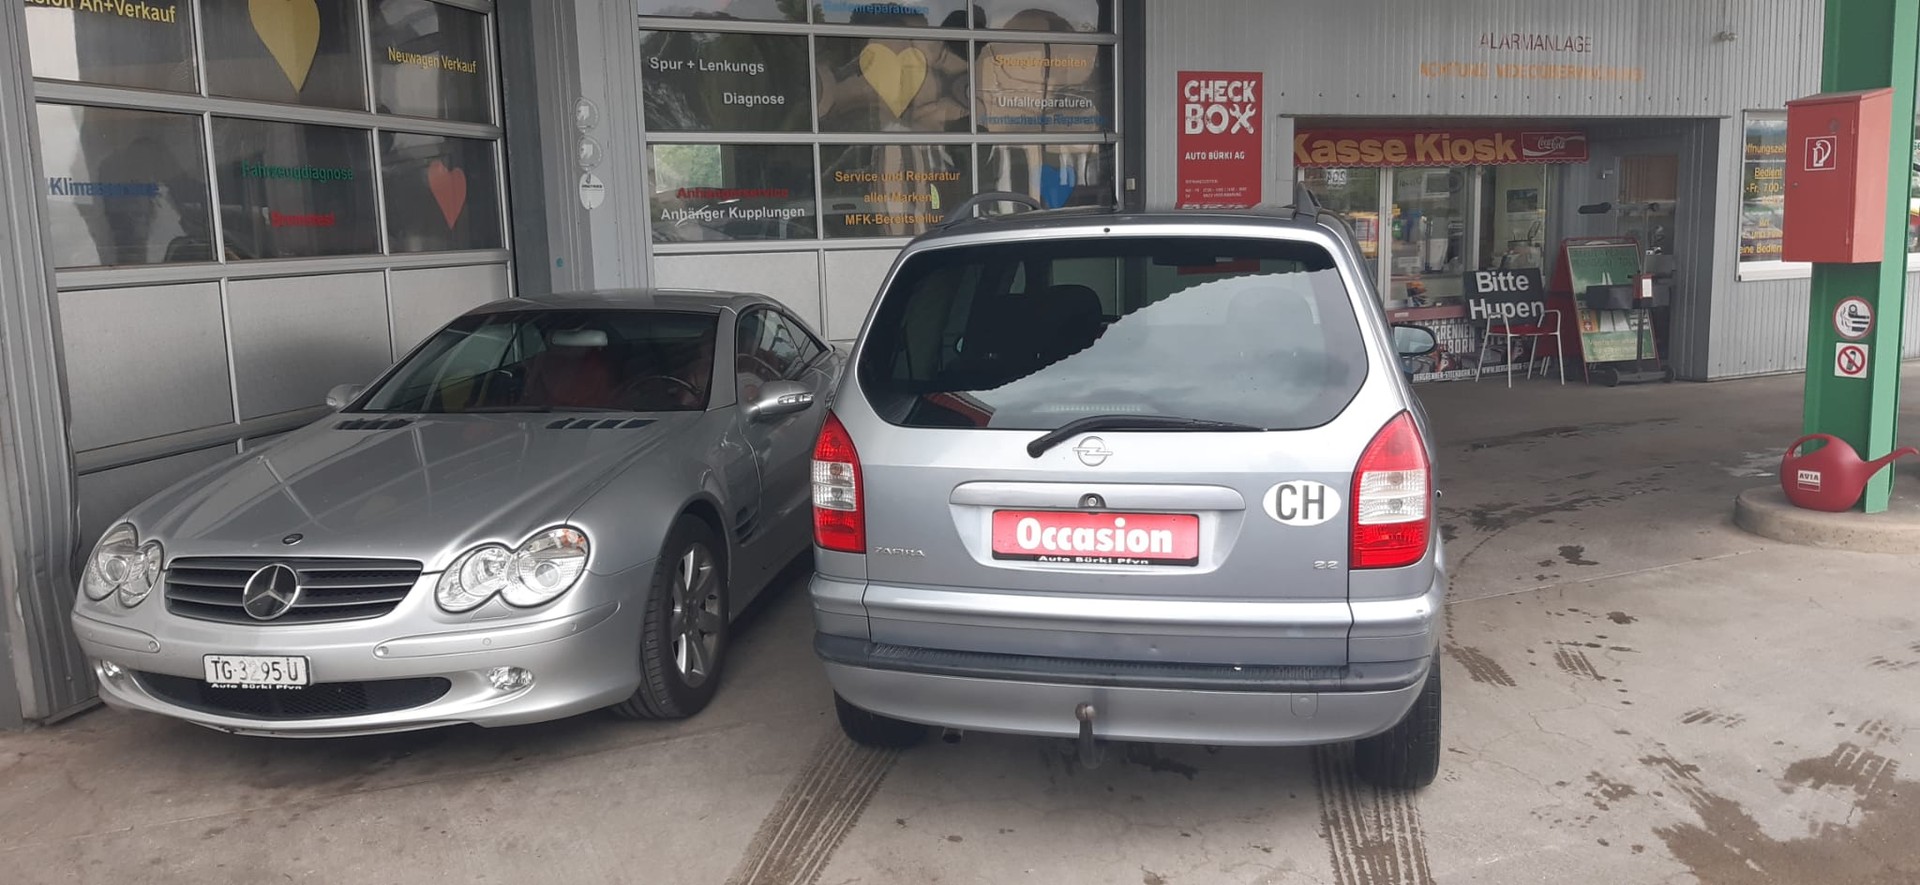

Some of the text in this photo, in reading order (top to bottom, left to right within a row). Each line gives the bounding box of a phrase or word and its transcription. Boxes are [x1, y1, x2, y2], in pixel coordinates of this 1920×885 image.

[1480, 32, 1592, 53] ALARMANLAGE
[387, 45, 477, 74] Neuwagen Verkauf
[649, 56, 765, 75] Spur + Lenkungs
[723, 92, 785, 107] Diagnose
[1184, 80, 1257, 102] CHECK
[997, 96, 1093, 112] Unfallreparaturen
[1185, 150, 1245, 161] AUTO BÜRKI AG
[1294, 132, 1517, 164] Kasse Kiosk
[834, 170, 961, 182] Service und Reparatur
[864, 192, 932, 203] aller Marken
[661, 205, 805, 223] Anhänger Kupplungen
[1476, 270, 1530, 293] Bitte
[1469, 298, 1545, 321] Hupen
[1799, 472, 1819, 481] AVIA
[1276, 484, 1324, 520] CH
[1016, 517, 1173, 553] Occasion
